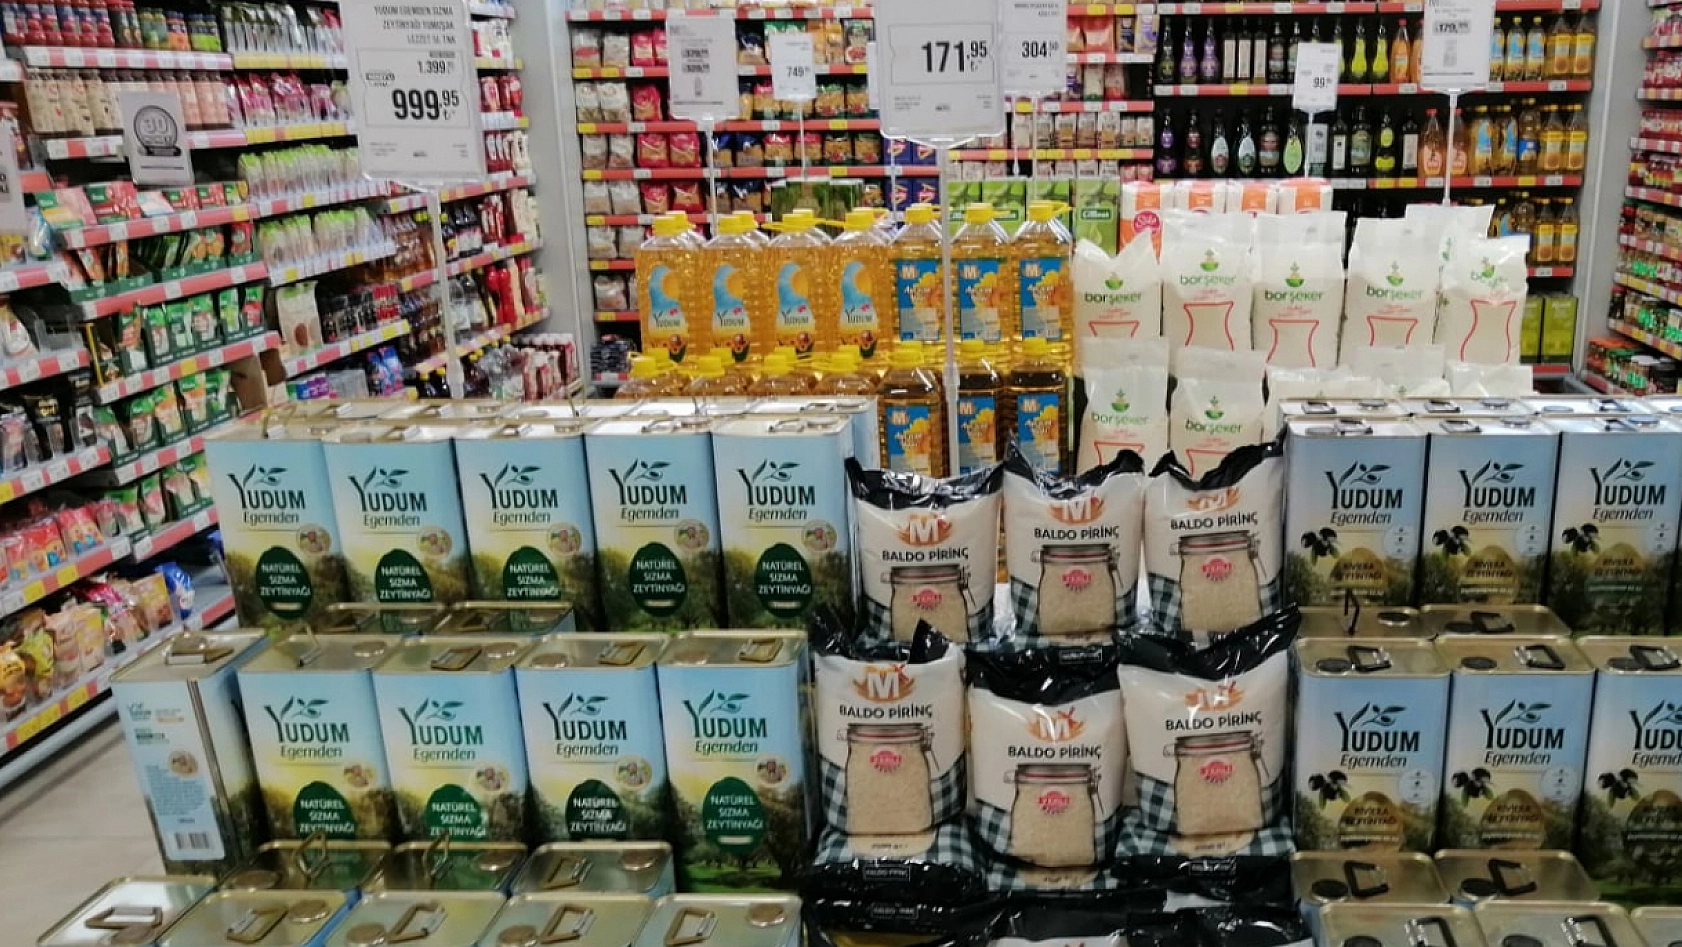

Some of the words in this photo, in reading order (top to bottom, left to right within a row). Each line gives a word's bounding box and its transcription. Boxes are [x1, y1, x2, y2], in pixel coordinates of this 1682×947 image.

[243, 511, 299, 527] Egemden
[364, 513, 420, 528] Egemden
[493, 511, 550, 526] Egemden
[621, 507, 679, 522] Egemden
[748, 507, 807, 522] Egemden
[1171, 516, 1214, 530] BALDO
[1218, 511, 1258, 528] PİRİNÇ
[1330, 511, 1392, 527] Egemden
[1463, 509, 1523, 525] Egemden
[1592, 507, 1653, 522] Egemden
[1034, 527, 1077, 541] BALDO
[1081, 525, 1120, 540] PİRİNÇ
[882, 550, 925, 563] BALDO
[929, 547, 969, 562] PİRİNÇ
[840, 704, 884, 719] BALDO
[888, 703, 933, 719] PİRİNÇ
[1166, 717, 1214, 731] BALDO
[1219, 711, 1262, 728] PİRİNÇ
[281, 745, 342, 760] Egemden
[414, 748, 475, 762] Egemden
[557, 743, 619, 758] Egemden
[695, 740, 758, 755] Egemden
[1008, 745, 1055, 759] BALDO
[1059, 743, 1102, 759] PİRİNÇ
[1340, 753, 1407, 769] Egemden
[1484, 751, 1551, 766] Egemden
